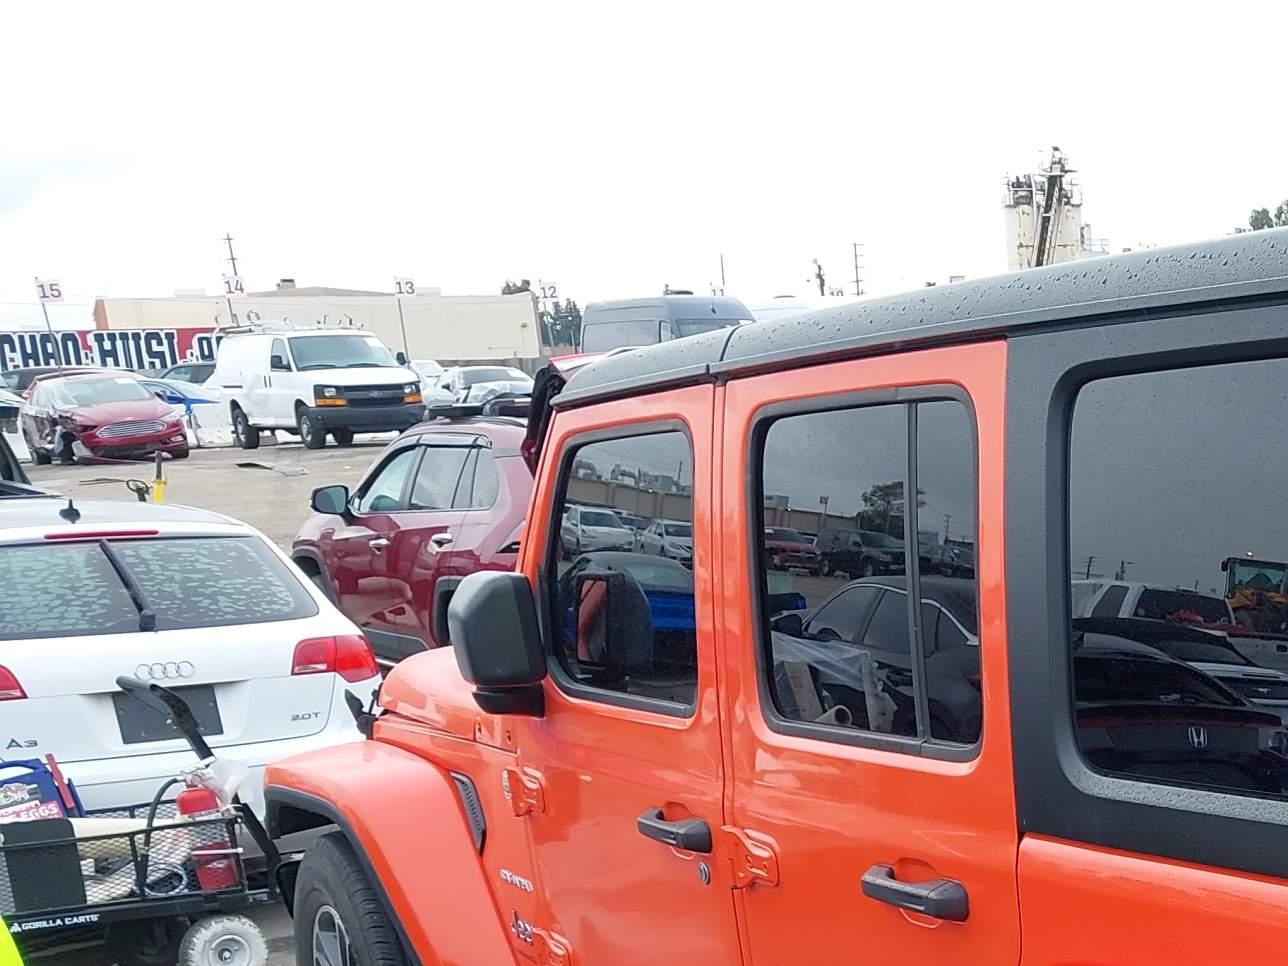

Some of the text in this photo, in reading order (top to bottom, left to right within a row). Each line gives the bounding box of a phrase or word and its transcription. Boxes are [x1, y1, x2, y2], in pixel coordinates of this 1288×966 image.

[37, 283, 62, 299] 15
[224, 279, 244, 294] 14
[395, 281, 416, 295] 13
[540, 286, 558, 299] 12
[5, 737, 38, 749] A3
[21, 914, 98, 931] GORILLA CARTS
